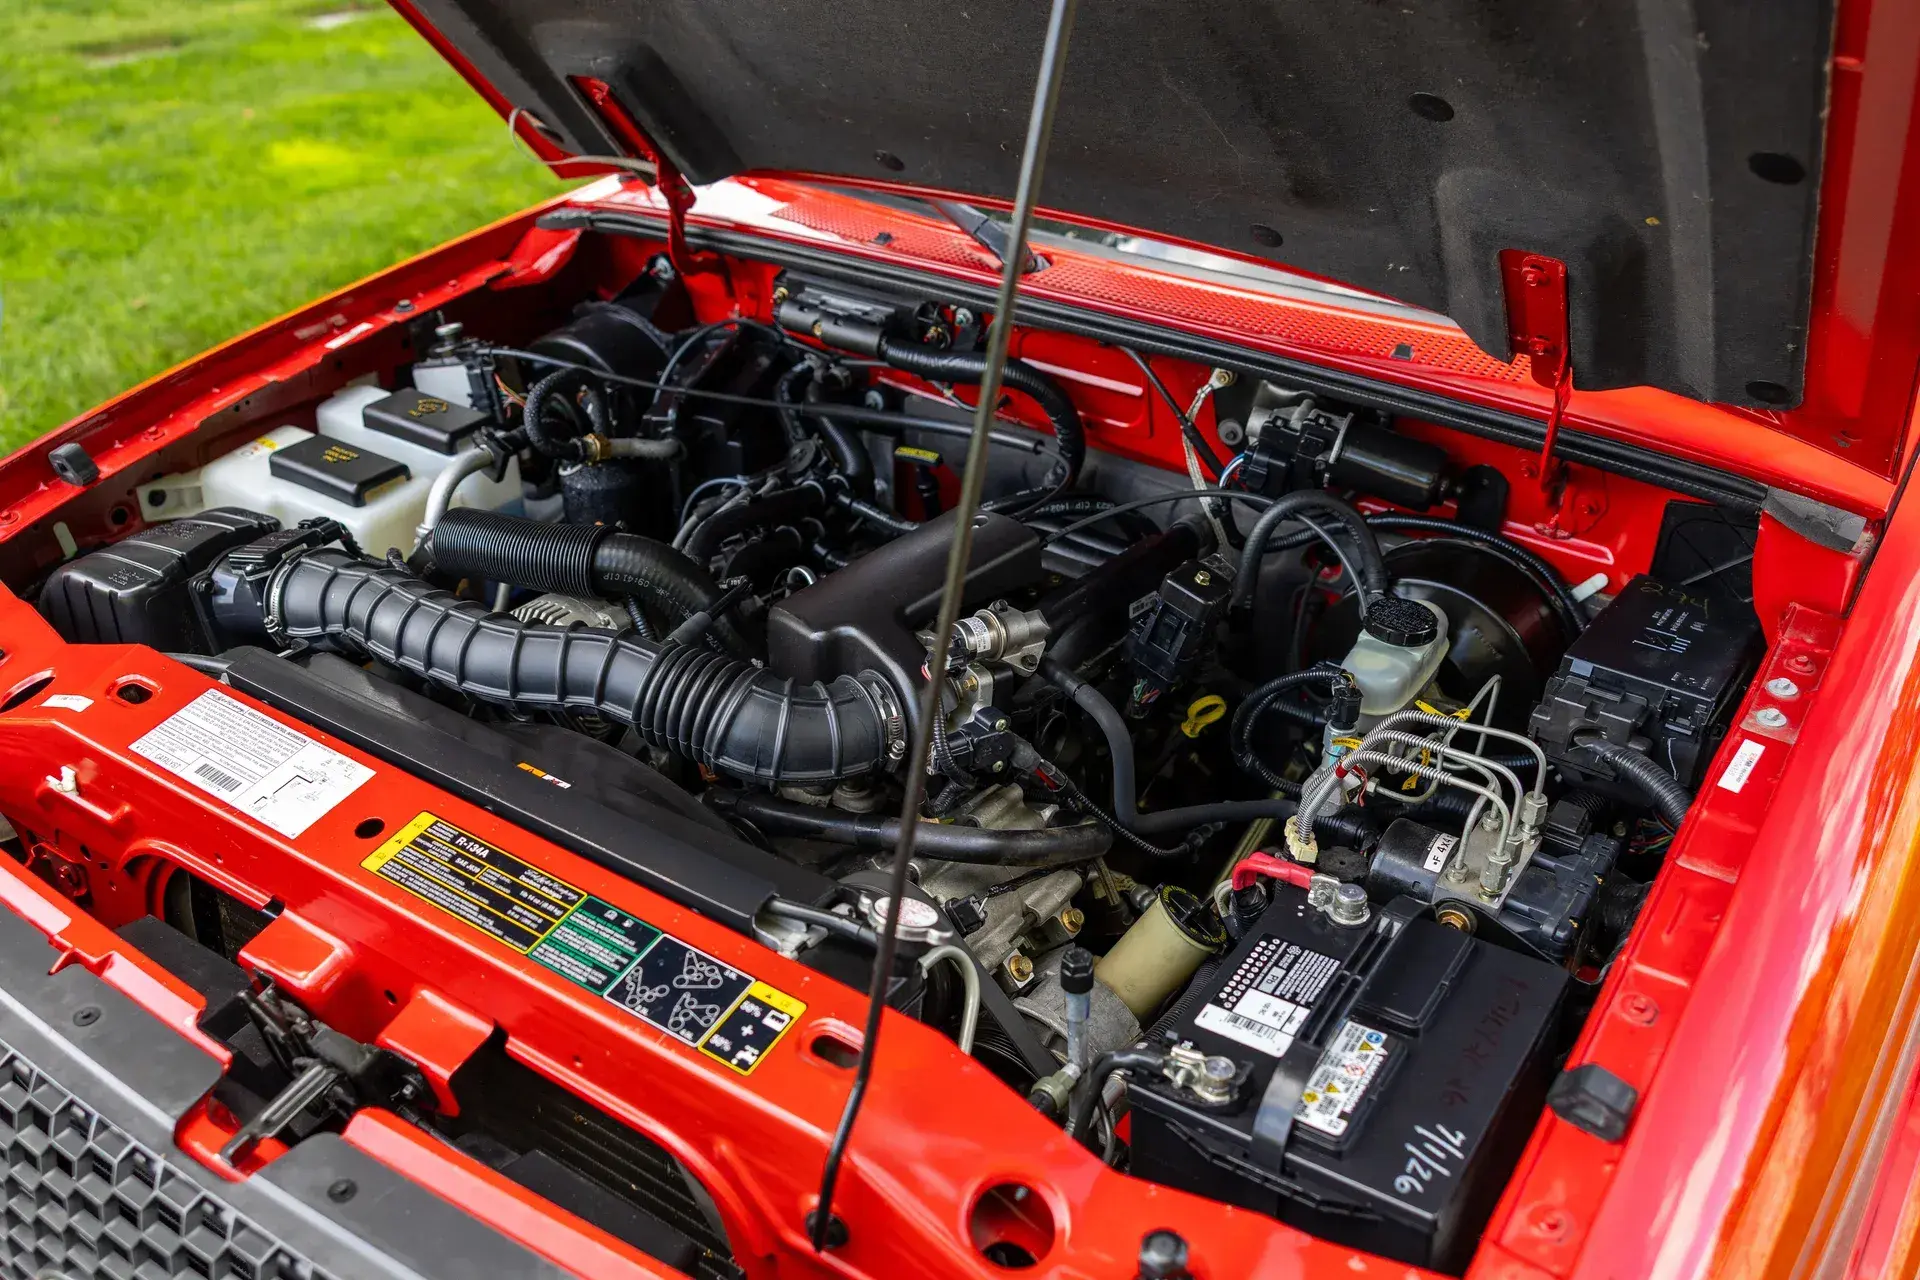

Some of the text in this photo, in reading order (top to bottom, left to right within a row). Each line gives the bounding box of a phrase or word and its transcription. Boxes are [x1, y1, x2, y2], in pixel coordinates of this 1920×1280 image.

[153, 752, 181, 769] CATALYST
[453, 836, 491, 858] R-134A
[1264, 973, 1278, 985] Pb
[1393, 1123, 1466, 1194] 7/1/26
